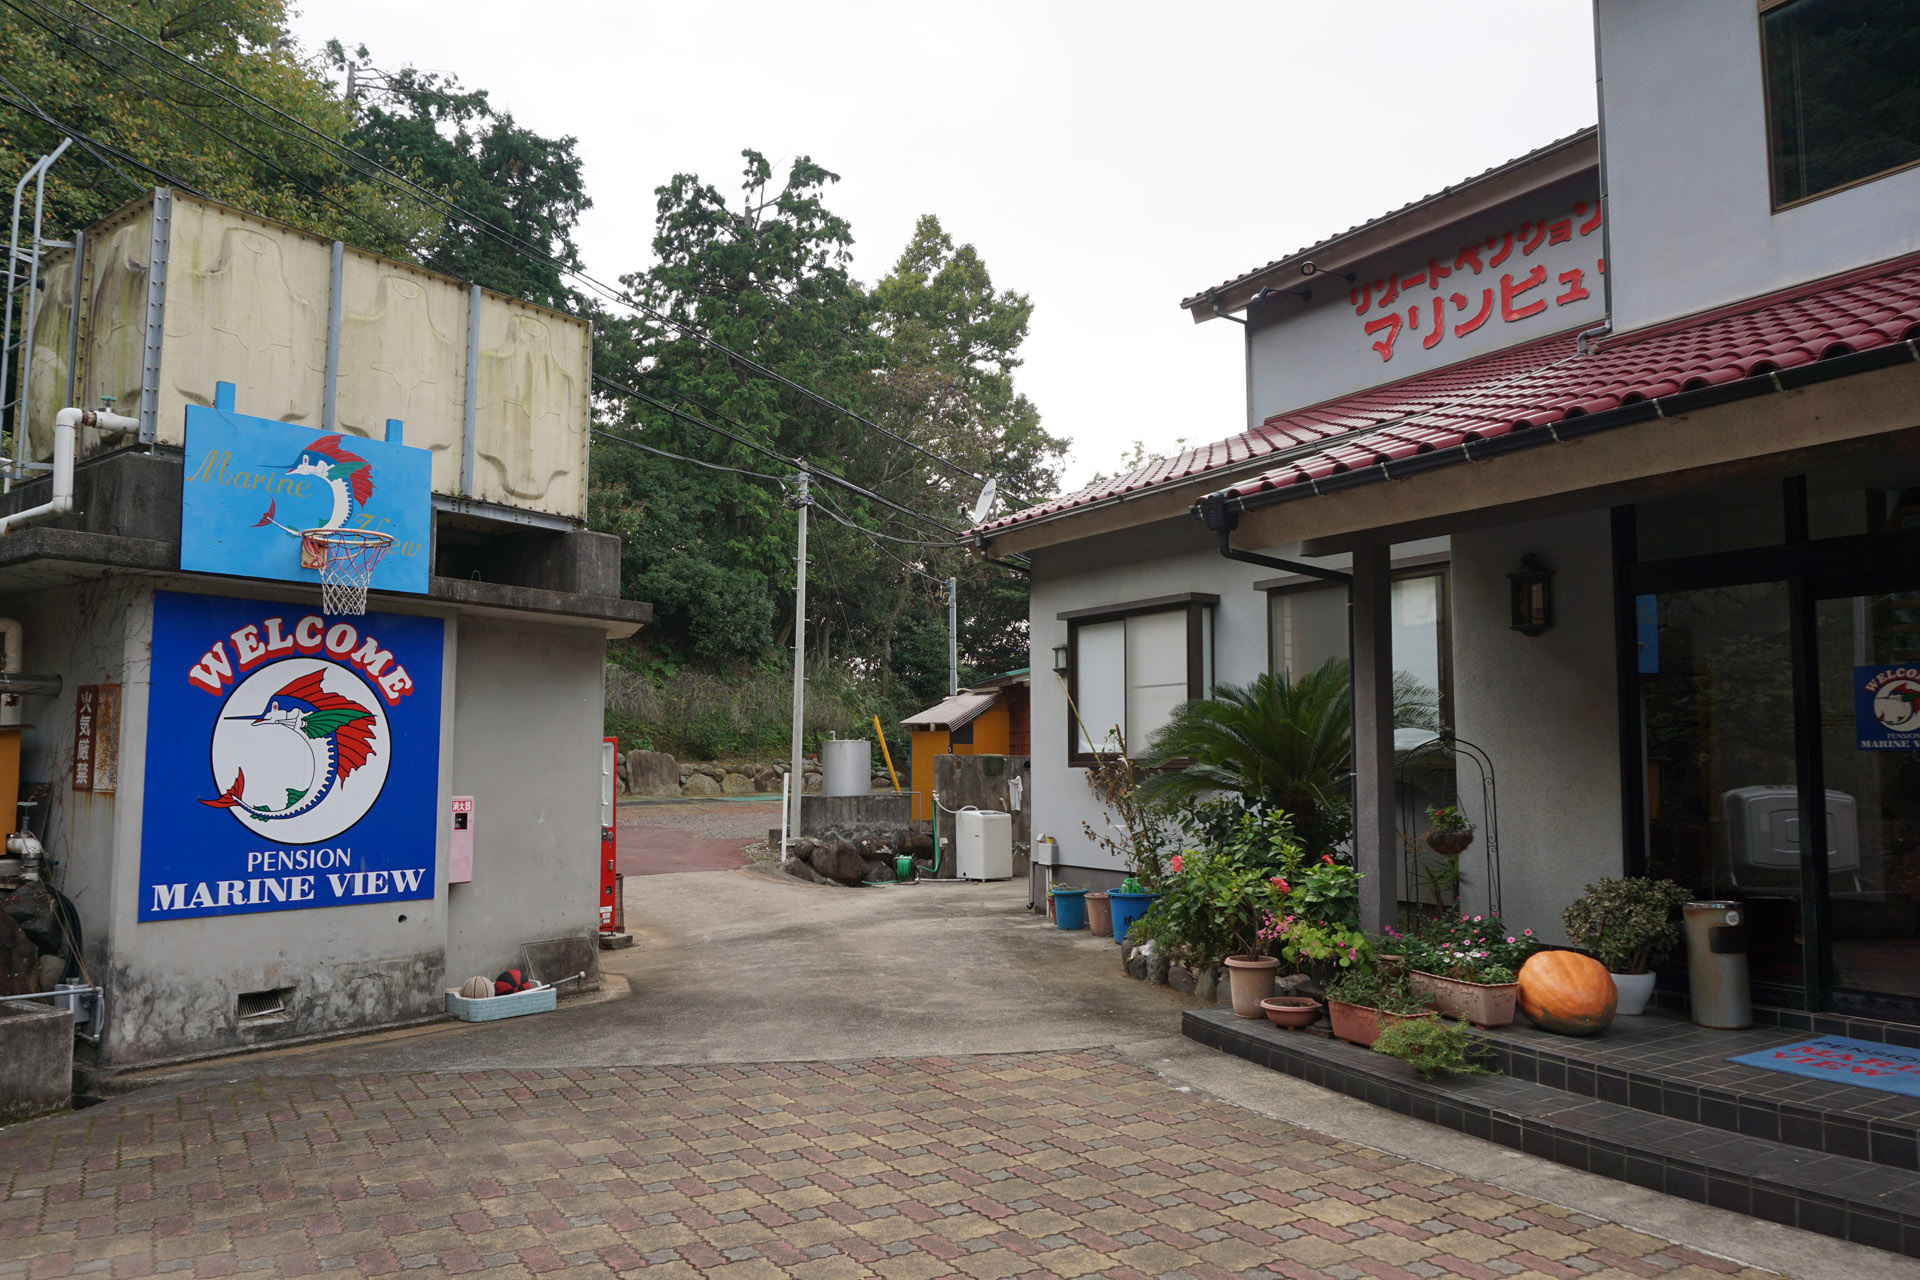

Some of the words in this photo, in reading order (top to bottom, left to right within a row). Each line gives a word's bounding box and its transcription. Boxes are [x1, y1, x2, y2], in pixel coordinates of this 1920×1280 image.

[1364, 258, 1605, 363] マリンビュ
[186, 449, 312, 498] Marine
[189, 615, 413, 704] WELCOME
[76, 691, 92, 784] 火気厳禁
[452, 801, 471, 811] 消火器
[247, 848, 351, 872] PENSION
[151, 876, 315, 912] MARINE
[326, 868, 426, 897] VIEW
[1773, 1051, 1896, 1076] VIEW
[1787, 1045, 1920, 1074] MARI
[1812, 1041, 1920, 1063] PENSIO
